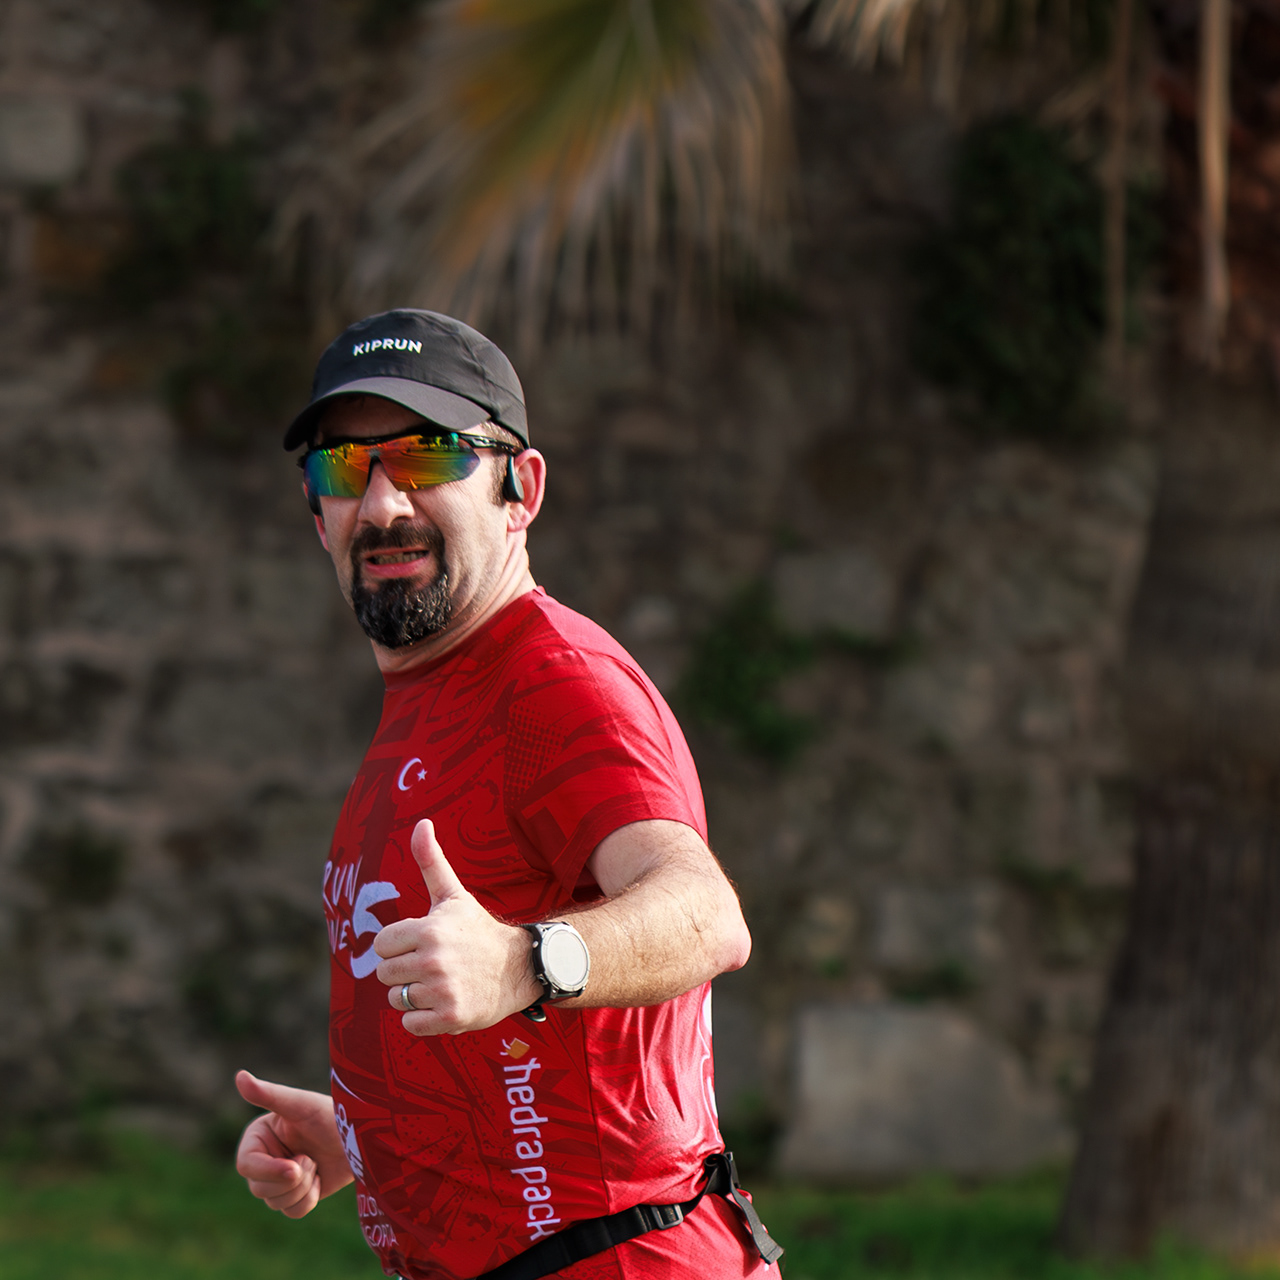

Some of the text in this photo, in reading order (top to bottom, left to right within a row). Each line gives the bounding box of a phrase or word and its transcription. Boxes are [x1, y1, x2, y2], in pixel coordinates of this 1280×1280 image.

[353, 338, 422, 356] KIPRUN
[503, 1057, 561, 1241] hedra pack
